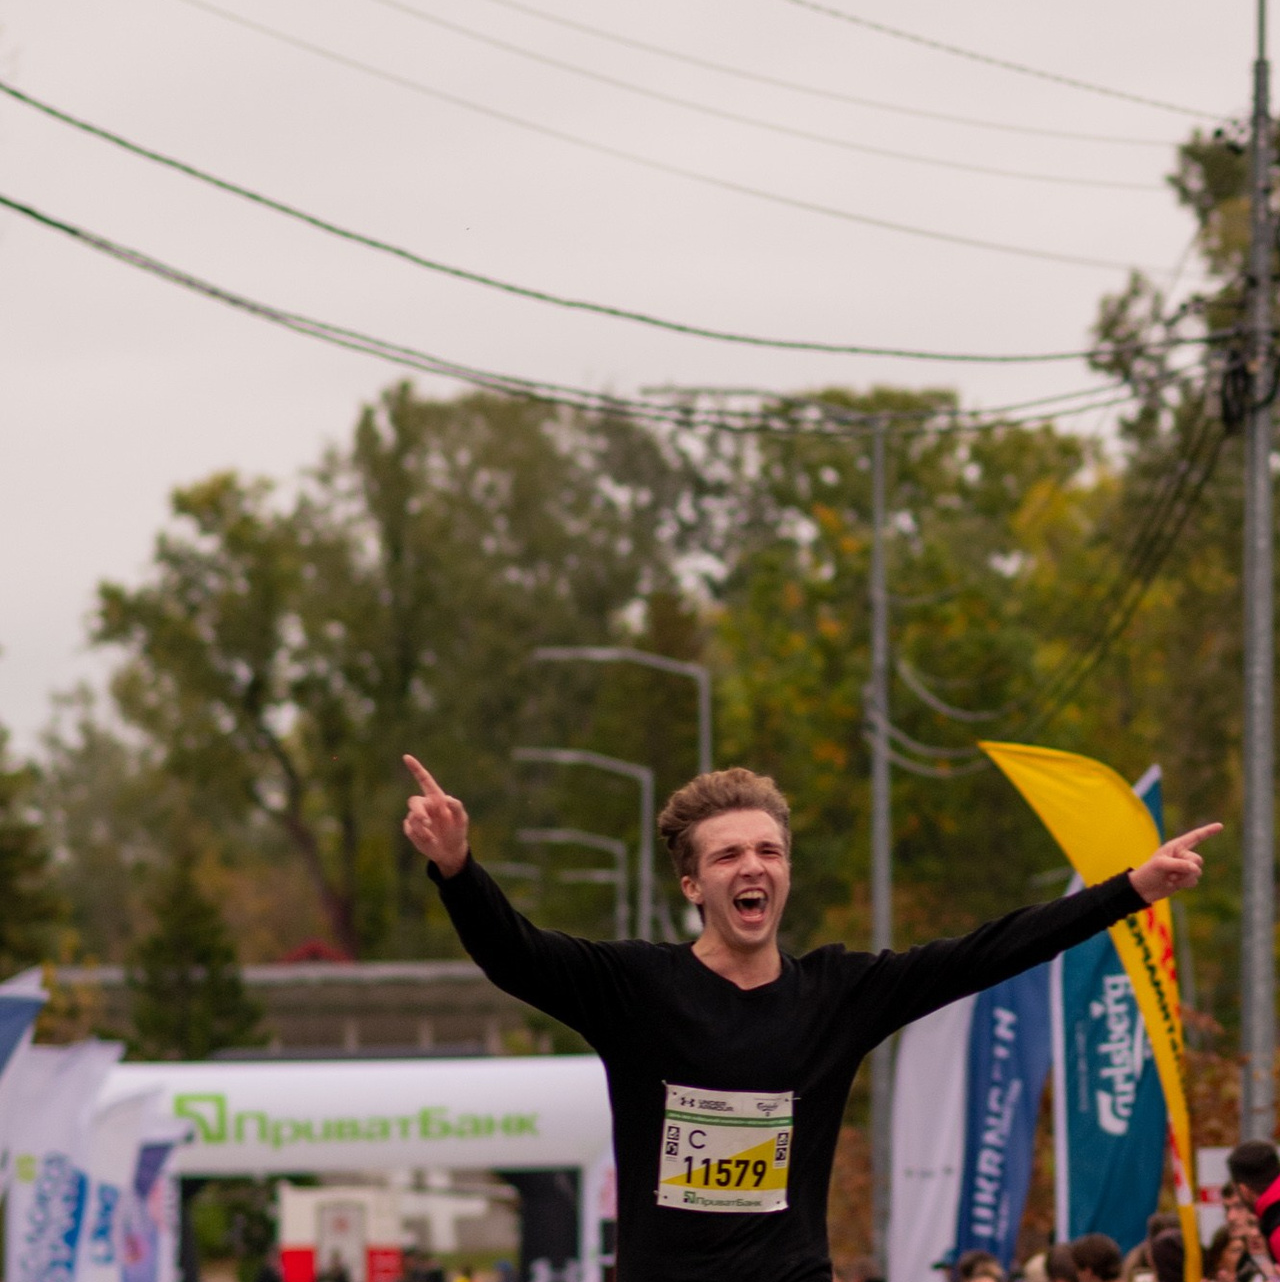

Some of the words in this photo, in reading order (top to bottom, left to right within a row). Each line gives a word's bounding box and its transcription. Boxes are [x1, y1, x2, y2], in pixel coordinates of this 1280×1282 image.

[1094, 974, 1137, 1137] Carlsberg
[234, 1106, 539, 1149] ПриватБанк
[683, 1155, 767, 1188] 11579
